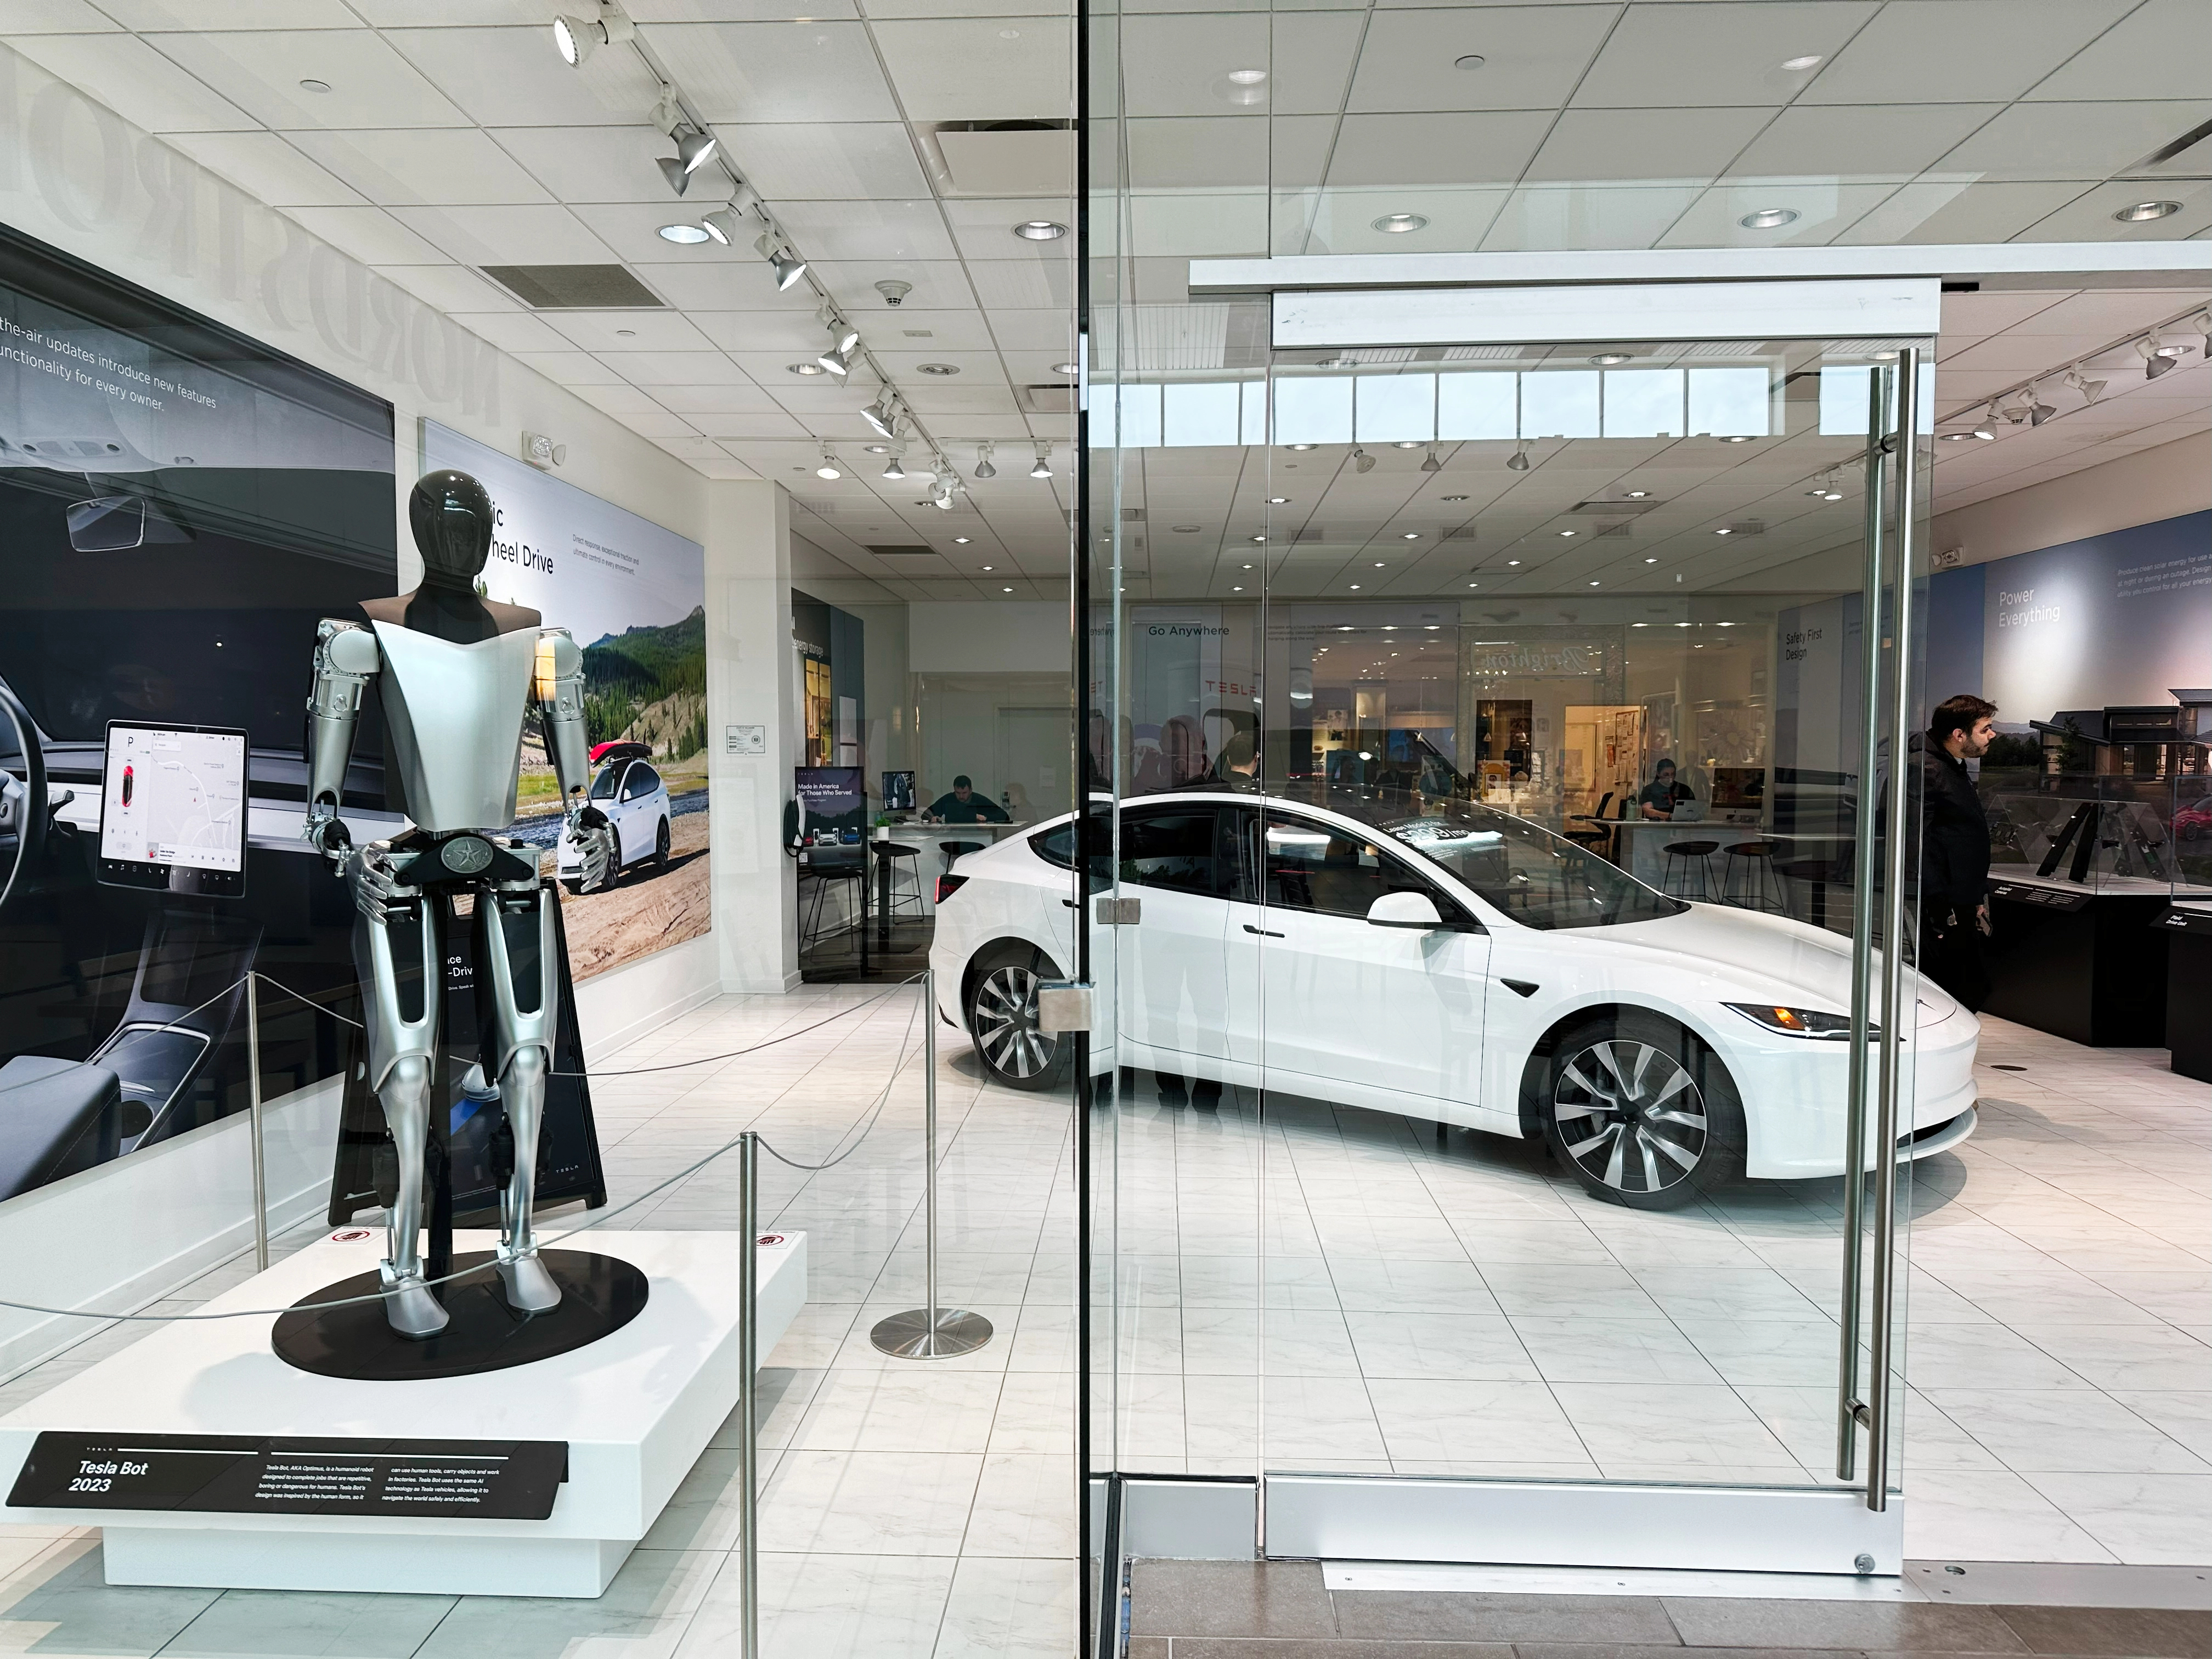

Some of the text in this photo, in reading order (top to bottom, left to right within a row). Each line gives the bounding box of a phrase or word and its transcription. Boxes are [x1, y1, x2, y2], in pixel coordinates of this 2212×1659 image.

[0, 317, 216, 408] the-air updates introduce new features
[76, 369, 92, 386] for
[96, 381, 126, 400] every
[129, 391, 164, 411] owner.
[573, 534, 584, 545] Direct
[523, 545, 553, 574] Drive
[589, 554, 601, 563] control
[606, 560, 614, 569] every
[2124, 578, 2137, 586] night
[2192, 565, 2211, 574] Design
[2143, 585, 2161, 593] control
[2179, 580, 2191, 589] your
[2193, 576, 2212, 585] energy
[2000, 589, 2034, 606] Power
[1999, 605, 2060, 627] Everything
[1148, 625, 1229, 637] Go Anywhere
[1786, 628, 1822, 645] Safety First
[794, 639, 823, 658] energy storage
[1786, 647, 1807, 661] Design
[1205, 680, 1257, 697] TESLA
[128, 736, 133, 747] P
[556, 1165, 578, 1173] TESLA
[78, 1460, 149, 1476] Tesla Bot
[68, 1477, 112, 1492] 2023
